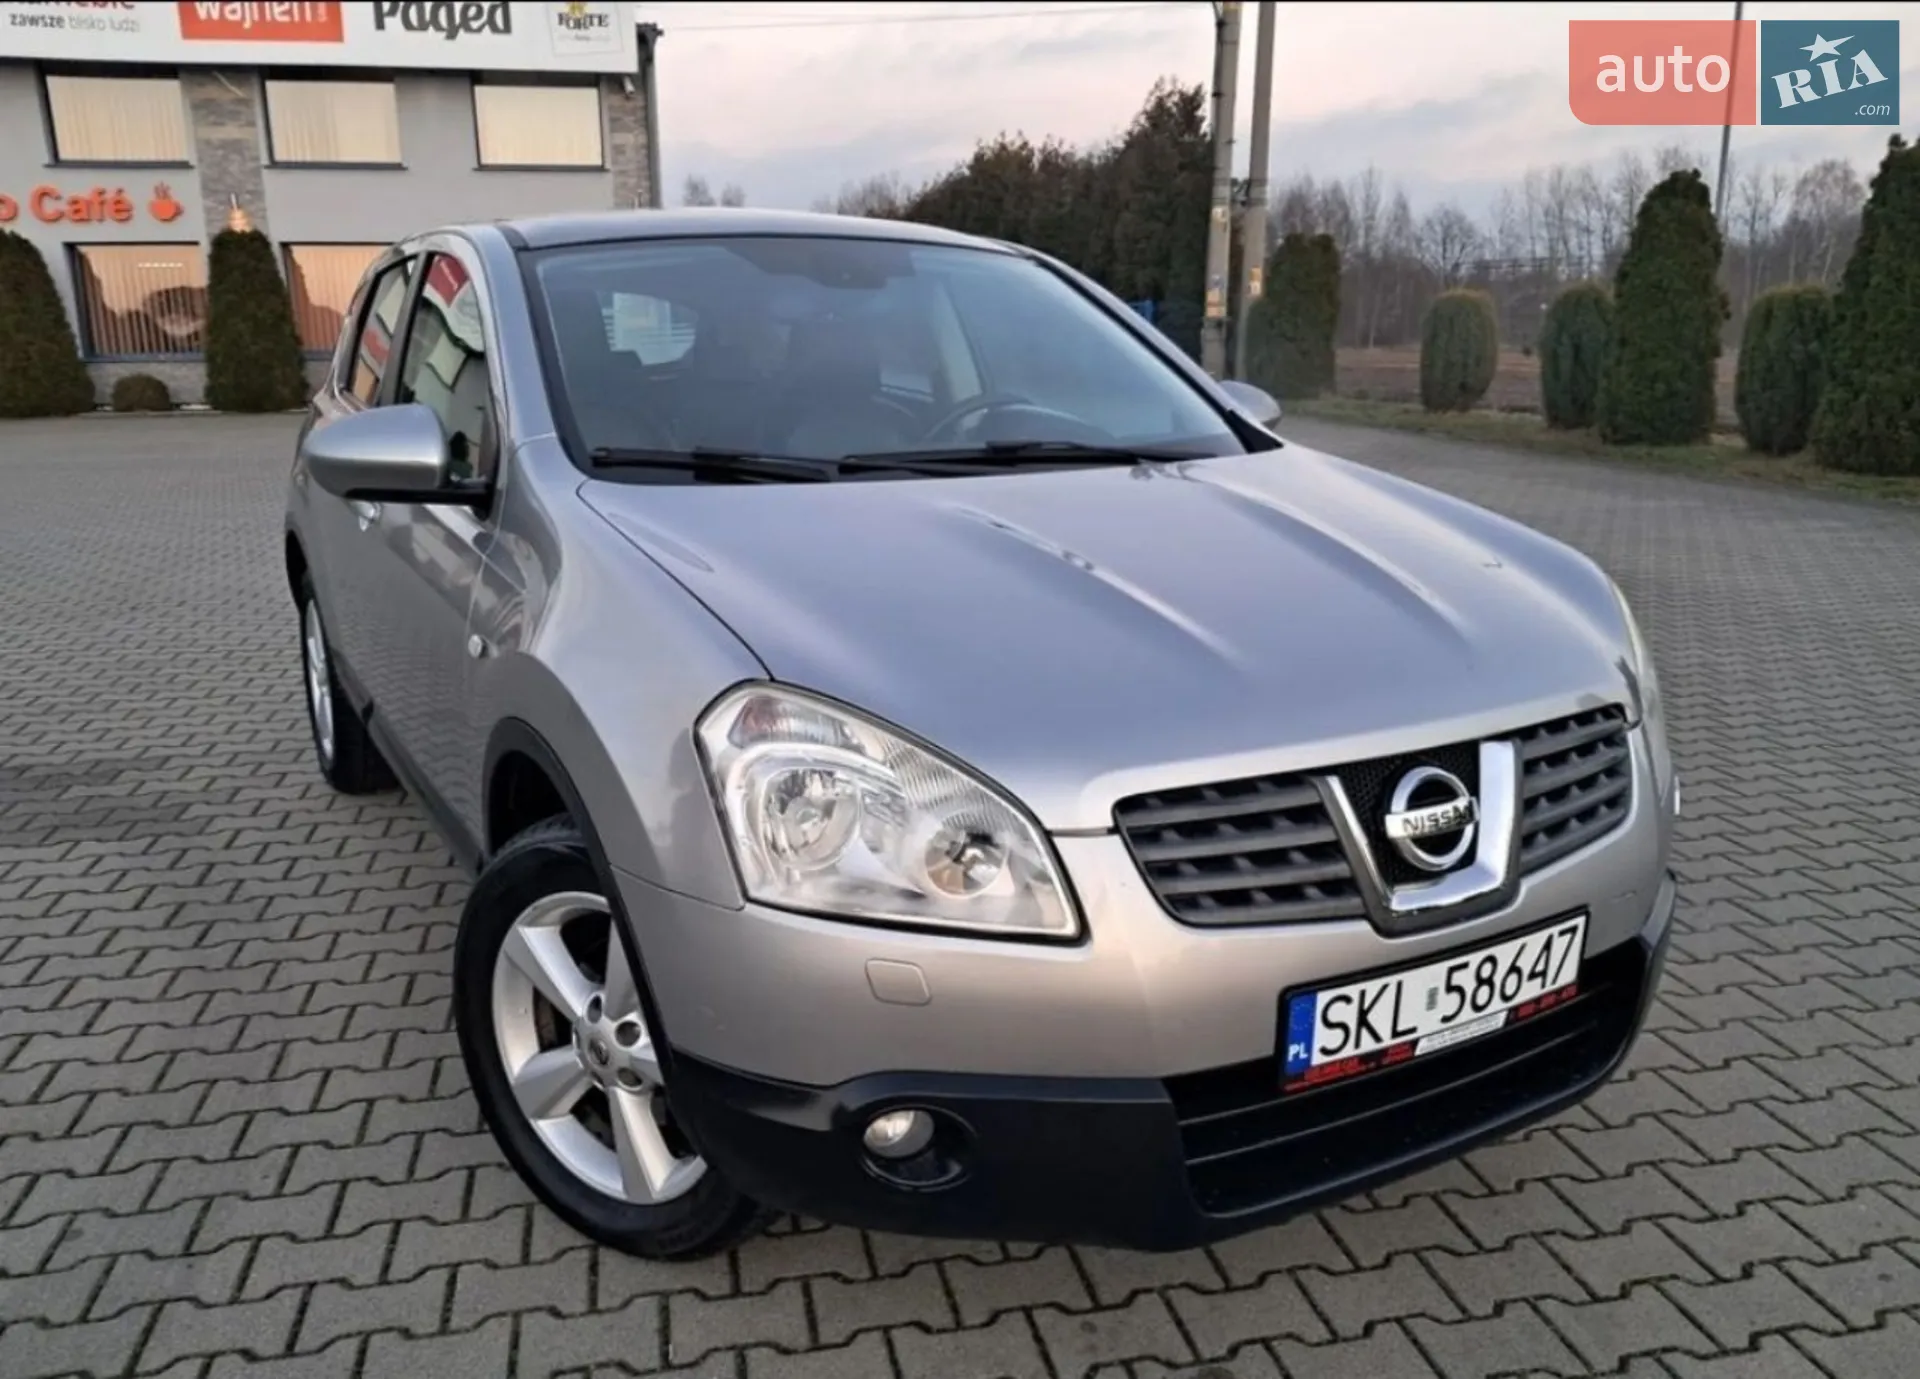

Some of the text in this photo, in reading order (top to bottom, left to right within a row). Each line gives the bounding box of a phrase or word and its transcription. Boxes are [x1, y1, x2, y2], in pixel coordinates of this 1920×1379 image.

[9, 13, 66, 29] zawsze
[373, 1, 512, 40] Paged
[30, 185, 134, 223] Café
[1319, 980, 1417, 1056] SKL
[1440, 924, 1579, 1023] 58647
[1287, 1043, 1309, 1062] PL
